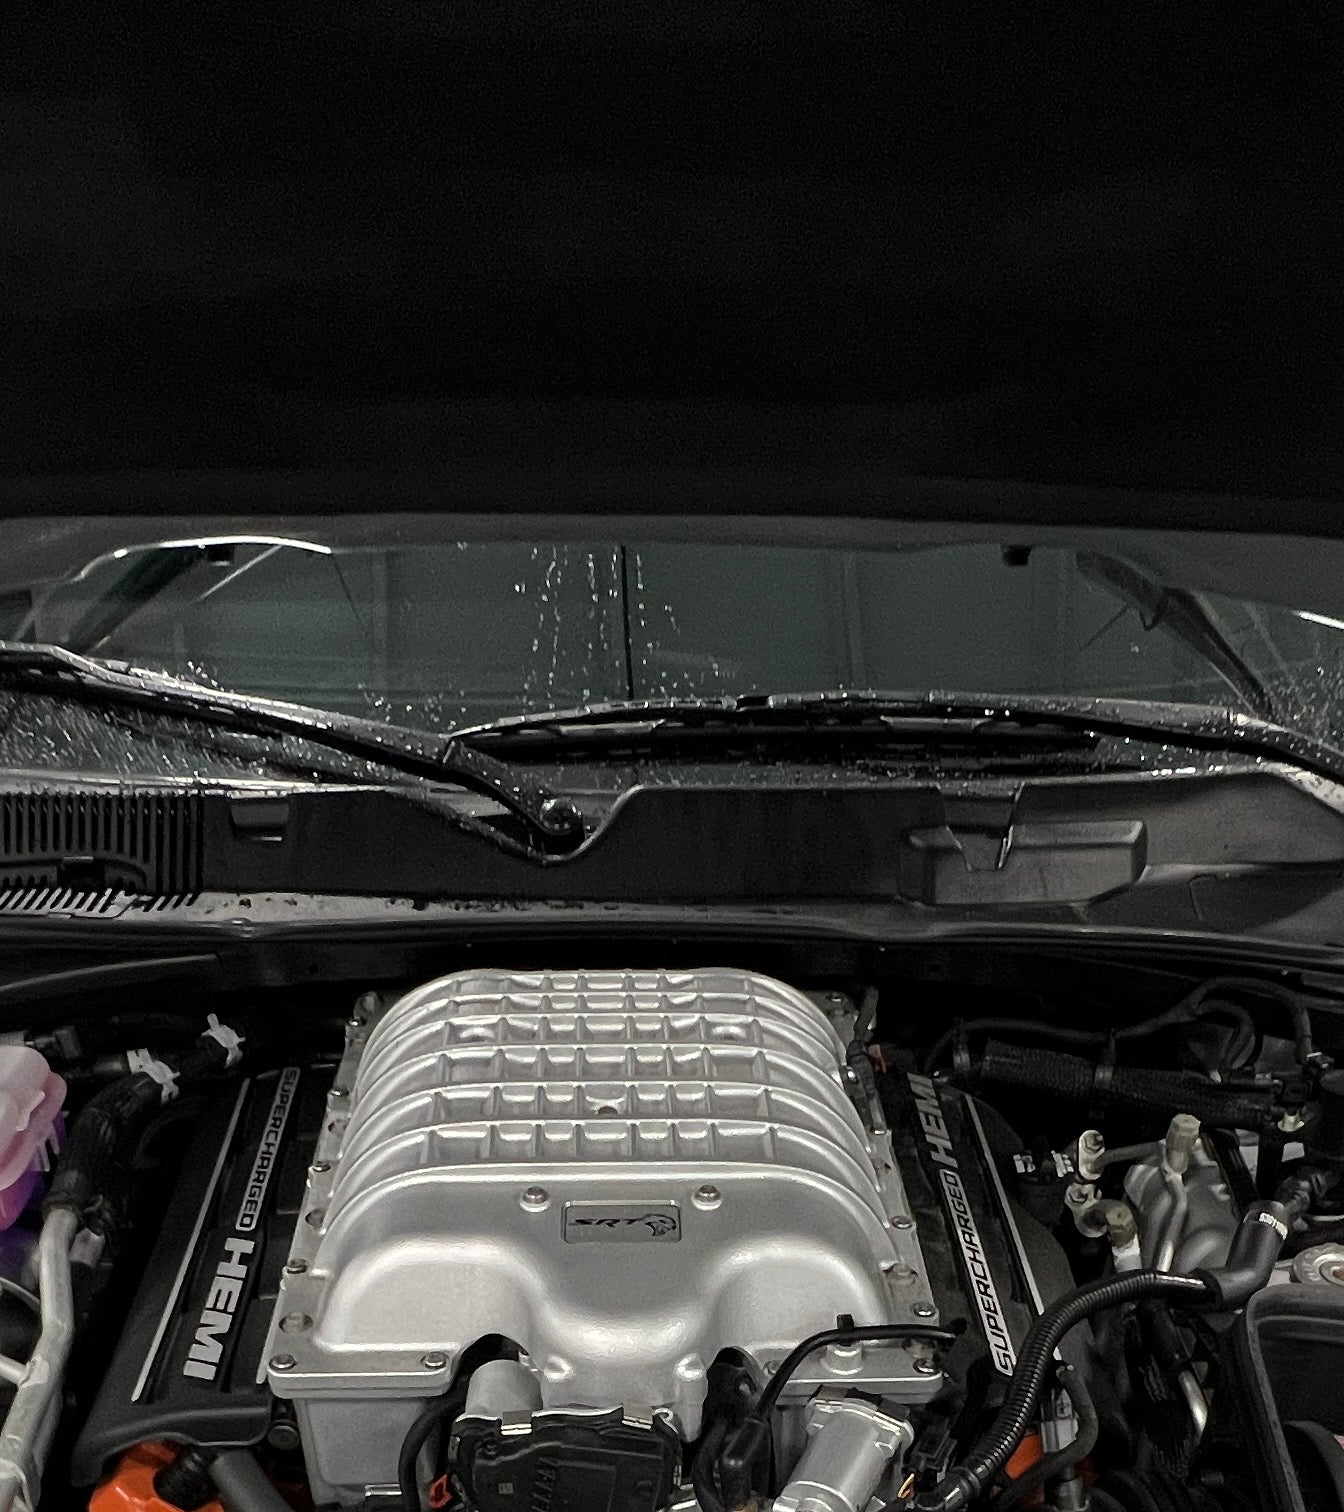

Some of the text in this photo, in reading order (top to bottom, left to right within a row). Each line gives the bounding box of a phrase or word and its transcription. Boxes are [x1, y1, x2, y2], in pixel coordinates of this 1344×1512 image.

[183, 1067, 298, 1381] SUPERCHARGED HEMI
[568, 1217, 641, 1229] SRT
[907, 1072, 1016, 1375] SUPERCHARGED HEMI
